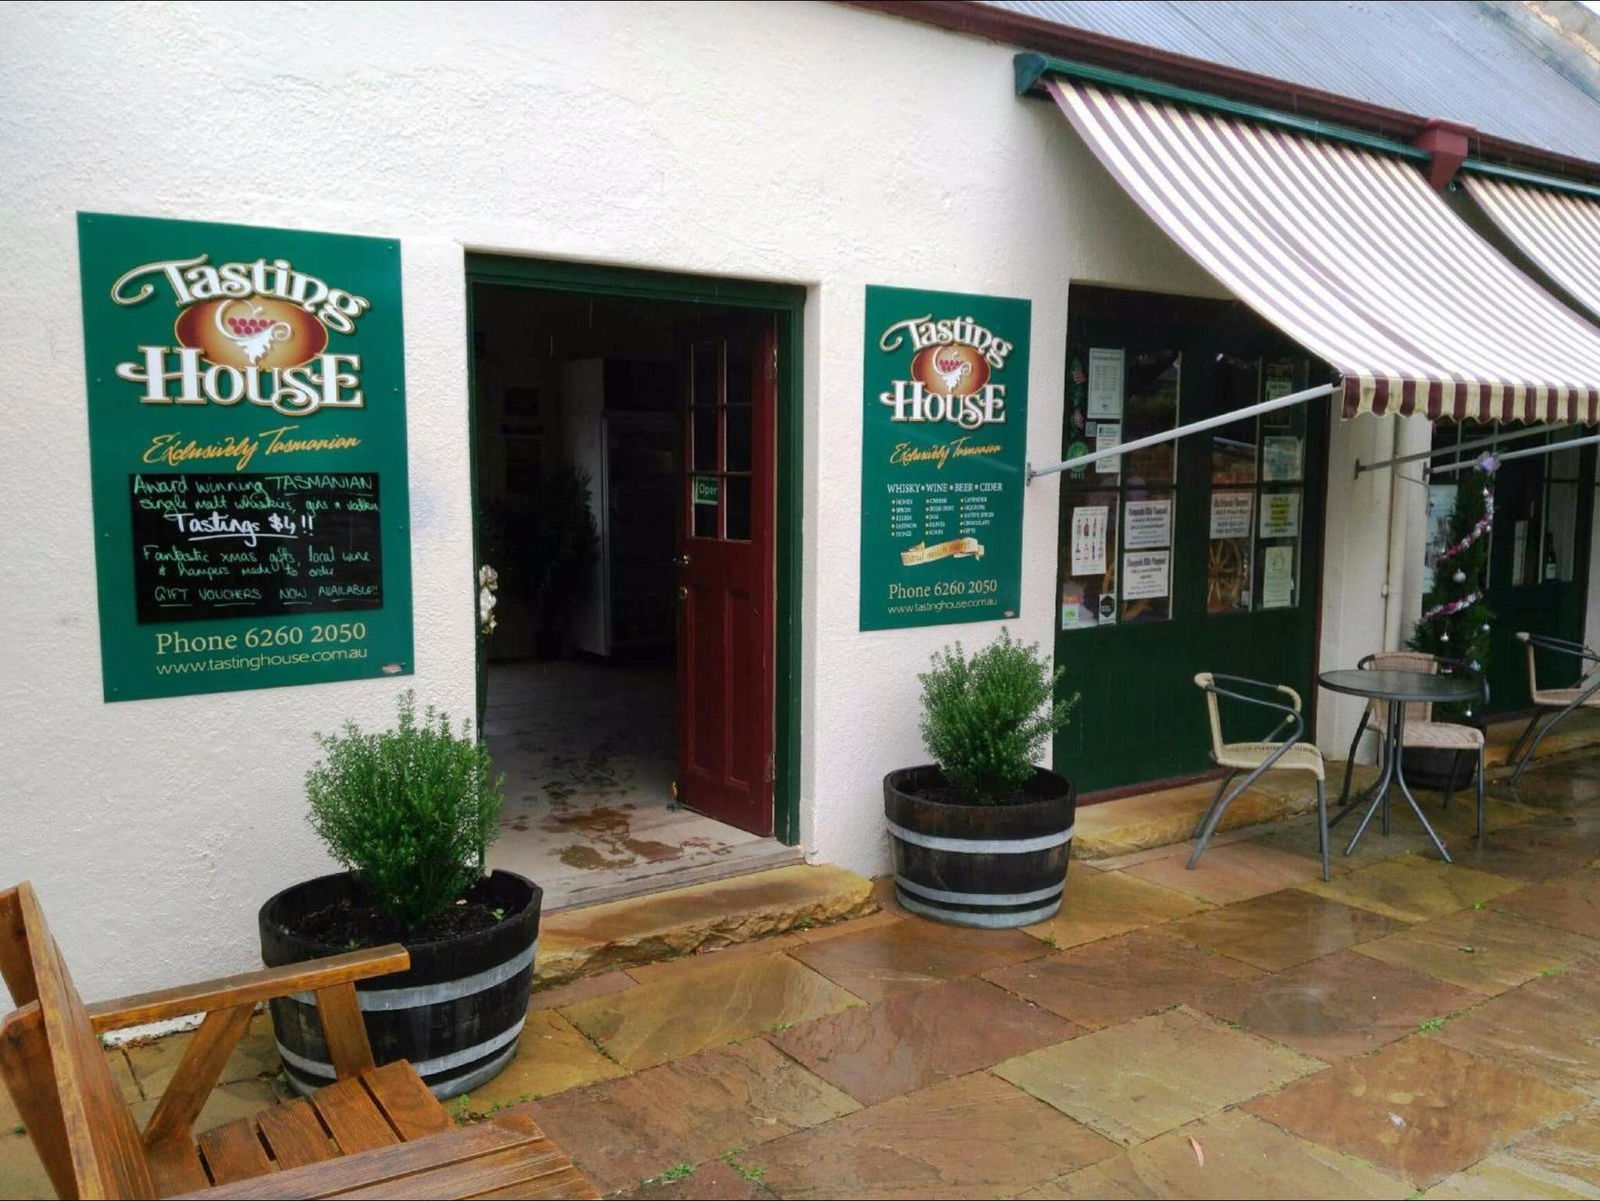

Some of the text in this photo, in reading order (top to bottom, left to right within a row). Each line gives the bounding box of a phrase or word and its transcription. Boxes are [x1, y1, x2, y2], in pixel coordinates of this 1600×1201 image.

[111, 254, 370, 335] Tasting
[879, 313, 1013, 370] Tasting
[115, 345, 364, 416] HOUSE
[879, 380, 1005, 430] HOUSE
[143, 425, 362, 471] Exclusively Tasmanian
[890, 436, 1003, 469] Exclusively Tasmanian
[134, 474, 372, 504] Award winning TASMANIAN
[887, 483, 1002, 493] WHISKY WINE BEER CIDER
[140, 494, 188, 521] single
[195, 495, 227, 510] malt
[163, 511, 260, 547] Tastings
[144, 545, 210, 563] Fantastic
[308, 545, 335, 562] local
[342, 552, 370, 562] wine
[178, 562, 230, 581] hampers
[285, 564, 298, 577] to
[155, 586, 189, 602] GIFT
[198, 588, 262, 600] VOUCHERS
[280, 588, 307, 599] NOW
[888, 579, 998, 599] Phone 6260 2050
[888, 598, 998, 614] www.tastinghouse.com.au
[156, 622, 366, 655] Phone 6260 2050
[156, 648, 368, 675] www.tastinghouse.com.au
